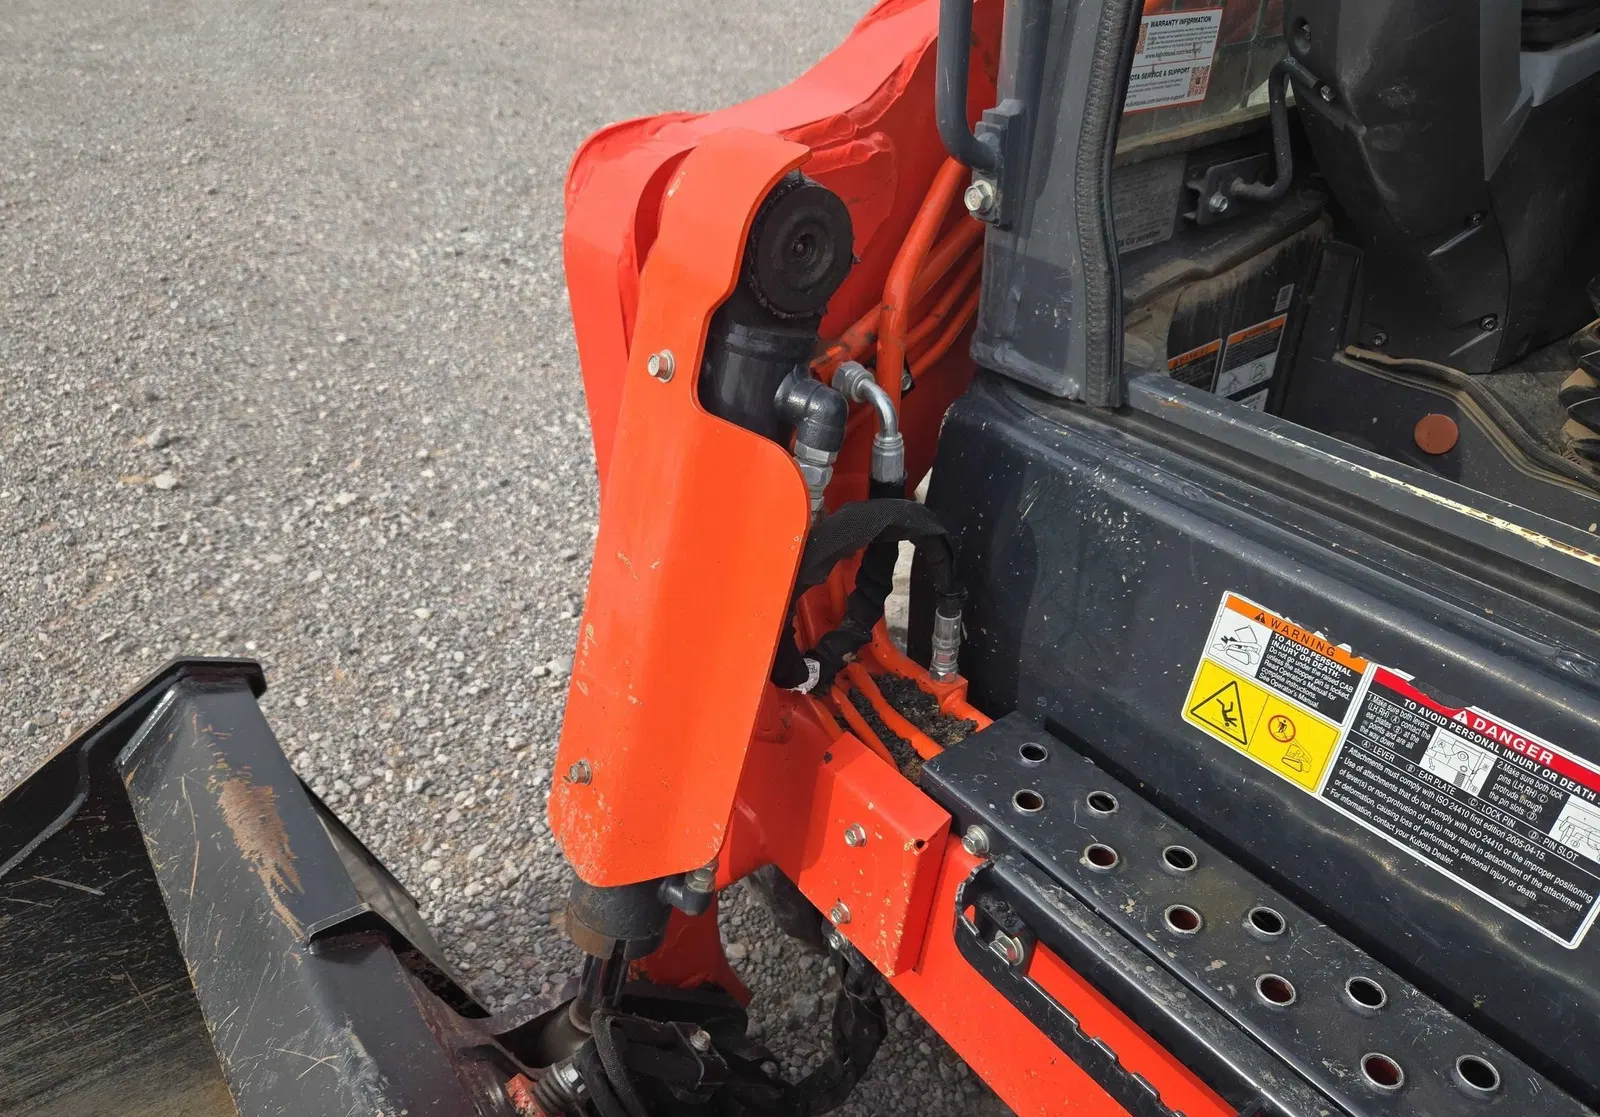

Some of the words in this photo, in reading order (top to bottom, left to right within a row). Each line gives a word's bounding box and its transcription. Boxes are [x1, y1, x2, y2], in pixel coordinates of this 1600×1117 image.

[1151, 19, 1178, 28] WARRANTY
[1179, 16, 1211, 25] INFORMATION
[1142, 70, 1162, 79] SERVICE
[1168, 68, 1190, 76] SUPPORT
[1271, 618, 1335, 657] WARNING
[1269, 646, 1277, 654] Do
[1278, 651, 1287, 659] not
[1295, 660, 1312, 671] under
[1311, 668, 1321, 676] the
[1321, 674, 1340, 686] raised
[1339, 682, 1354, 693] CAB
[1271, 640, 1299, 657] INJURY
[1299, 654, 1311, 664] OR
[1312, 660, 1340, 679] DEATH:
[1275, 633, 1285, 642] TO
[1285, 639, 1309, 654] AVOID
[1310, 651, 1351, 677] PERSONAL
[1259, 672, 1272, 682] See
[1270, 677, 1297, 697] Operator's
[1298, 693, 1319, 708] Manual.
[1261, 667, 1285, 682] complete
[1285, 678, 1316, 699] instructions.
[1264, 659, 1279, 671] Read
[1279, 667, 1306, 685] Operator's
[1307, 681, 1328, 696] Manual
[1328, 692, 1336, 700] for
[1266, 654, 1284, 666] unless
[1284, 661, 1293, 670] the
[1293, 668, 1315, 681] stopper
[1314, 678, 1324, 686] pin
[1330, 685, 1350, 700] locked.
[1366, 712, 1376, 720] ear
[1374, 717, 1392, 729] plates
[1410, 733, 1420, 744] the
[1368, 722, 1385, 734] points
[1384, 731, 1397, 740] and
[1396, 737, 1406, 745] are
[1387, 705, 1400, 715] sure
[1399, 710, 1413, 721] both
[1412, 716, 1430, 730] levers
[1401, 721, 1422, 735] contact
[1421, 730, 1431, 740] the
[1359, 725, 1369, 734] the
[1368, 731, 1380, 742] way
[1380, 737, 1395, 749] down.
[1404, 699, 1416, 710] TO
[1418, 707, 1447, 725] AVOID
[1449, 722, 1499, 753] PERSONAL
[1503, 749, 1541, 772] INJURY
[1542, 769, 1558, 782] OR
[1559, 777, 1596, 801] DEATH
[1473, 718, 1553, 765] DANGER
[1373, 746, 1395, 762] LEVER
[1348, 747, 1384, 771] Attachments
[1384, 767, 1400, 779] must
[1399, 776, 1422, 792] comply
[1422, 788, 1435, 799] with
[1435, 794, 1449, 806] ISO
[1448, 802, 1470, 818] 24410
[1470, 813, 1483, 826] first
[1483, 822, 1506, 838] edition
[1418, 770, 1433, 783] EAR
[1433, 778, 1456, 795] PLATE
[1492, 783, 1519, 800] protrude
[1497, 774, 1511, 785] pins
[1520, 774, 1534, 785] sure
[1534, 780, 1549, 793] both
[1549, 787, 1563, 800] lock
[1481, 804, 1502, 820] LOCK
[1502, 815, 1516, 828] PIN
[1489, 791, 1499, 801] the
[1498, 798, 1509, 807] pin
[1509, 803, 1525, 815] slots
[1330, 788, 1341, 798] For
[1340, 794, 1372, 819] information,
[1373, 815, 1395, 831] contact
[1394, 828, 1409, 839] your
[1409, 835, 1431, 852] Kubota
[1431, 848, 1453, 866] Dealer.
[1341, 783, 1375, 807] deformation,
[1376, 804, 1400, 821] causing
[1399, 815, 1413, 828] loss
[1419, 829, 1459, 856] performance,
[1460, 853, 1490, 872] personal
[1489, 868, 1508, 884] injury
[1517, 885, 1536, 901] death.
[1344, 757, 1356, 768] Use
[1362, 769, 1398, 792] attachments
[1398, 788, 1411, 800] that
[1411, 795, 1419, 804] do
[1420, 801, 1431, 811] not
[1431, 808, 1454, 824] comply
[1454, 820, 1468, 832] with
[1468, 827, 1482, 839] ISO
[1481, 835, 1503, 851] 24410
[1512, 852, 1523, 863] the
[1523, 858, 1555, 880] improper
[1553, 877, 1593, 904] positioning
[1345, 771, 1368, 789] lever(s)
[1374, 789, 1417, 817] non-protrusion
[1424, 818, 1443, 832] pin(s)
[1443, 828, 1458, 841] may
[1457, 837, 1477, 851] result
[1476, 846, 1484, 855] in
[1484, 851, 1523, 877] detachment
[1531, 877, 1542, 888] the
[1543, 885, 1582, 911] attachment
[1542, 838, 1557, 850] PIN
[1557, 845, 1579, 861] SLOT
